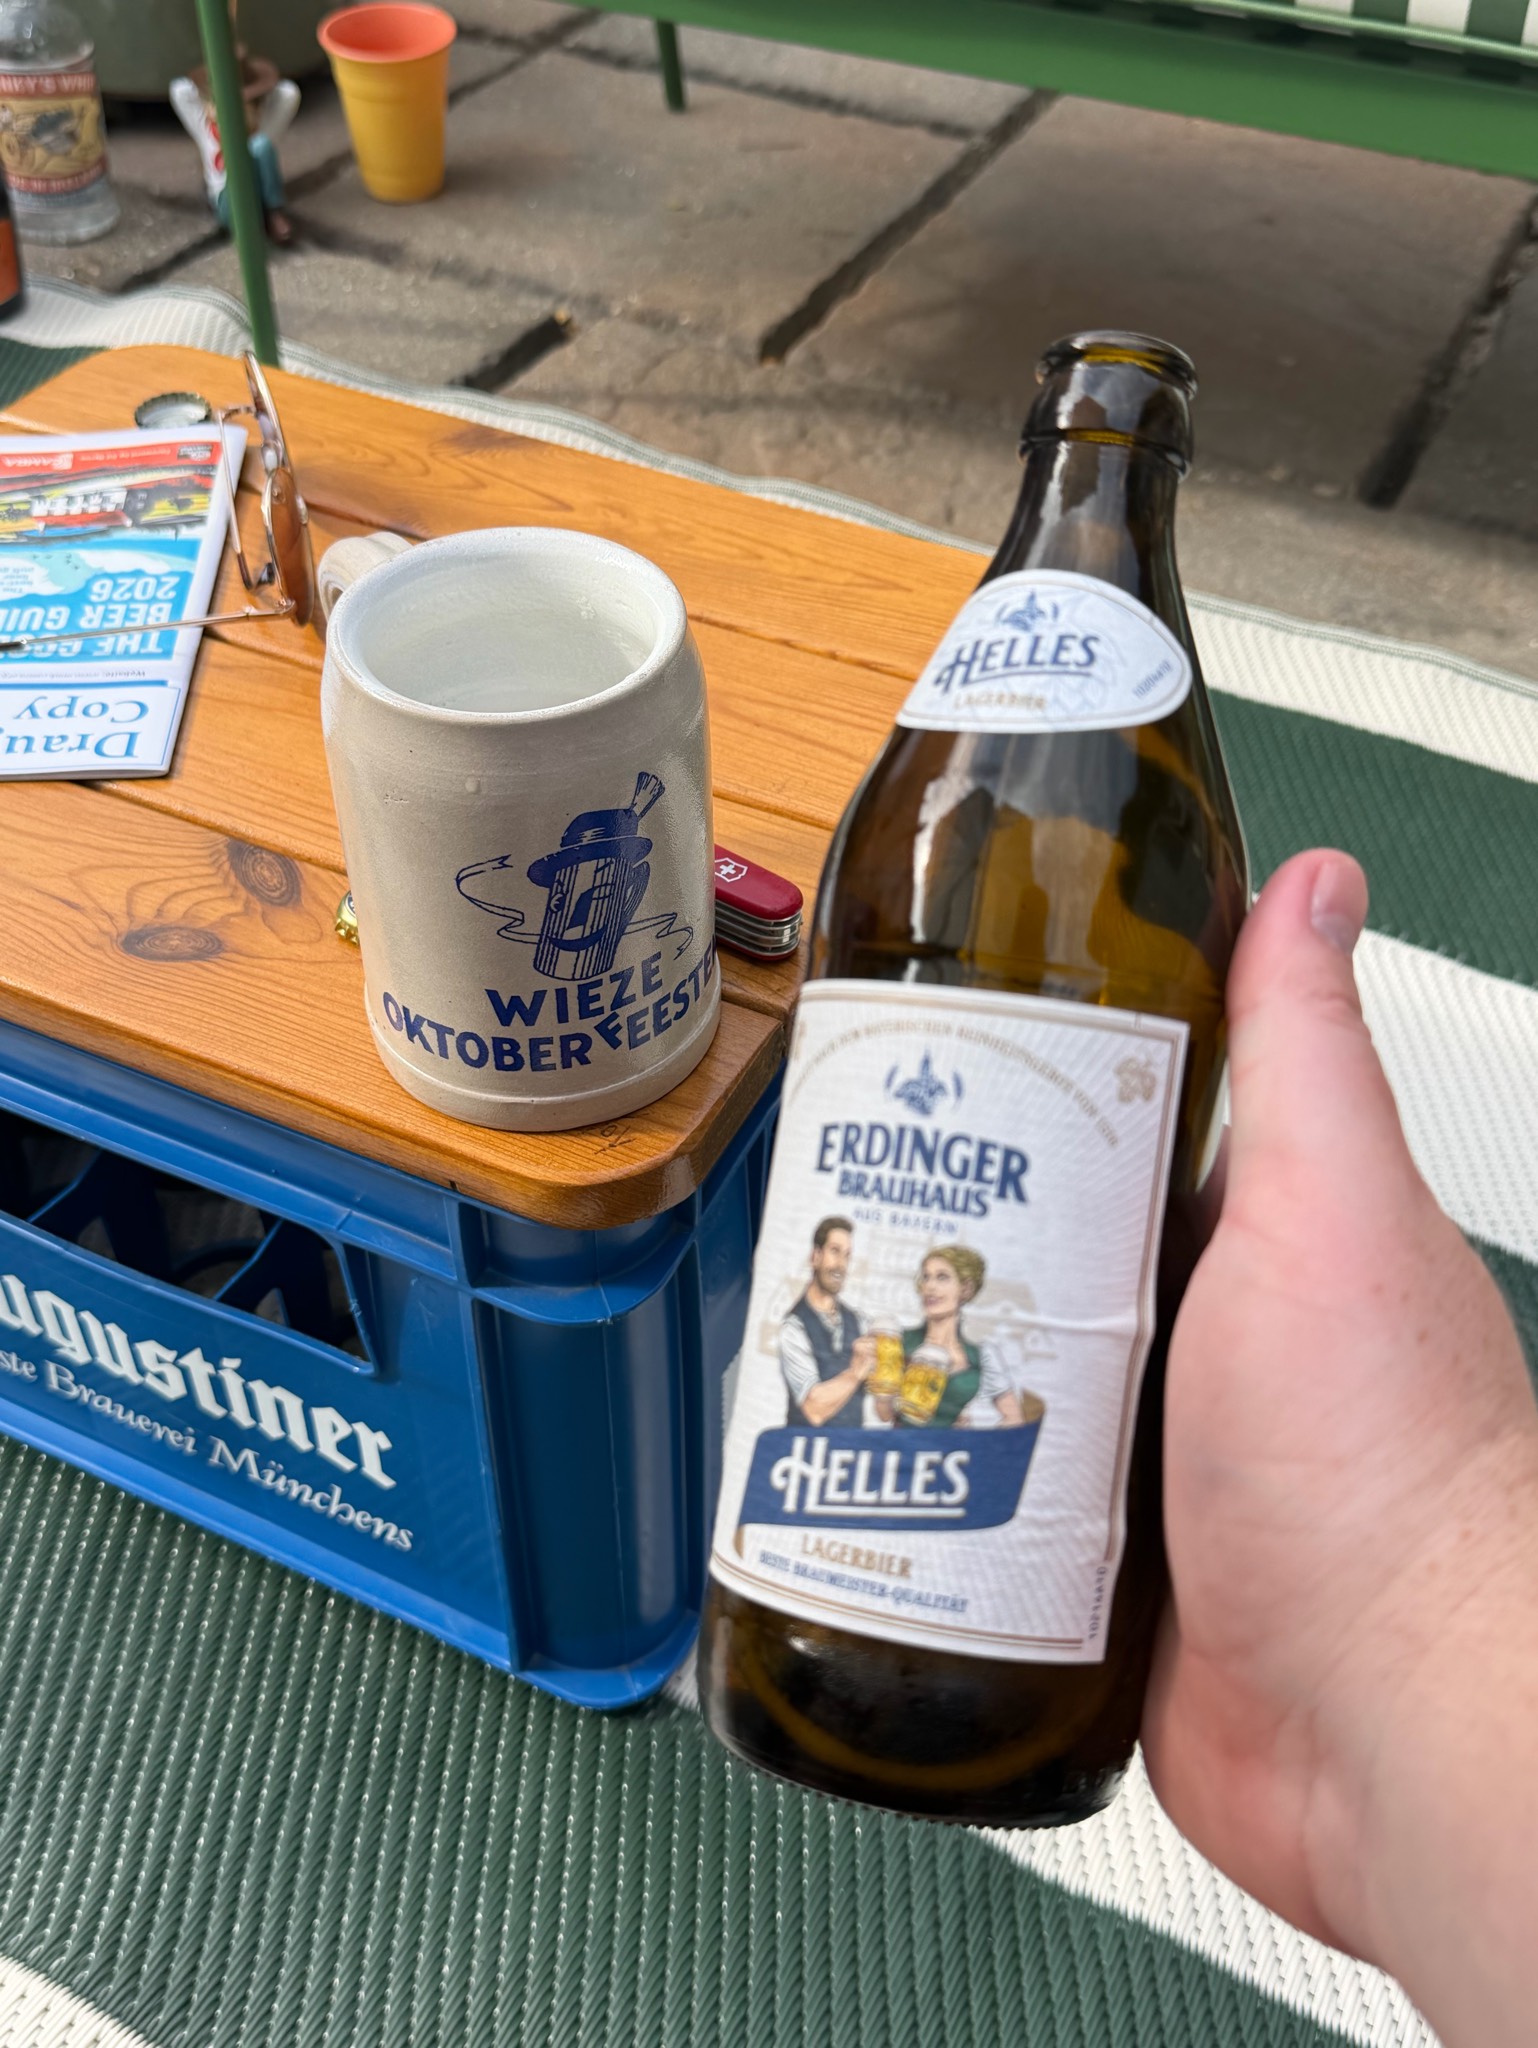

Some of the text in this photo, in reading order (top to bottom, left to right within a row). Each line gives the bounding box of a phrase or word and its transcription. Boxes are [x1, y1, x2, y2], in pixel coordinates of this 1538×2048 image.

[89, 576, 180, 602] 2026
[0, 602, 173, 632] BEER GUI
[93, 630, 164, 657] THE
[933, 634, 1100, 693] HELLES
[13, 696, 149, 723] Copy
[0, 727, 141, 758] Drau
[484, 951, 663, 1028] WIEZE
[815, 1122, 1030, 1204] ERDINGER
[837, 1168, 990, 1218] BRAUHAUS
[44, 1359, 198, 1456] Brauerei
[207, 1436, 414, 1552] Münchens
[770, 1435, 972, 1518] HELLES
[802, 1533, 913, 1579] LAGERBIER
